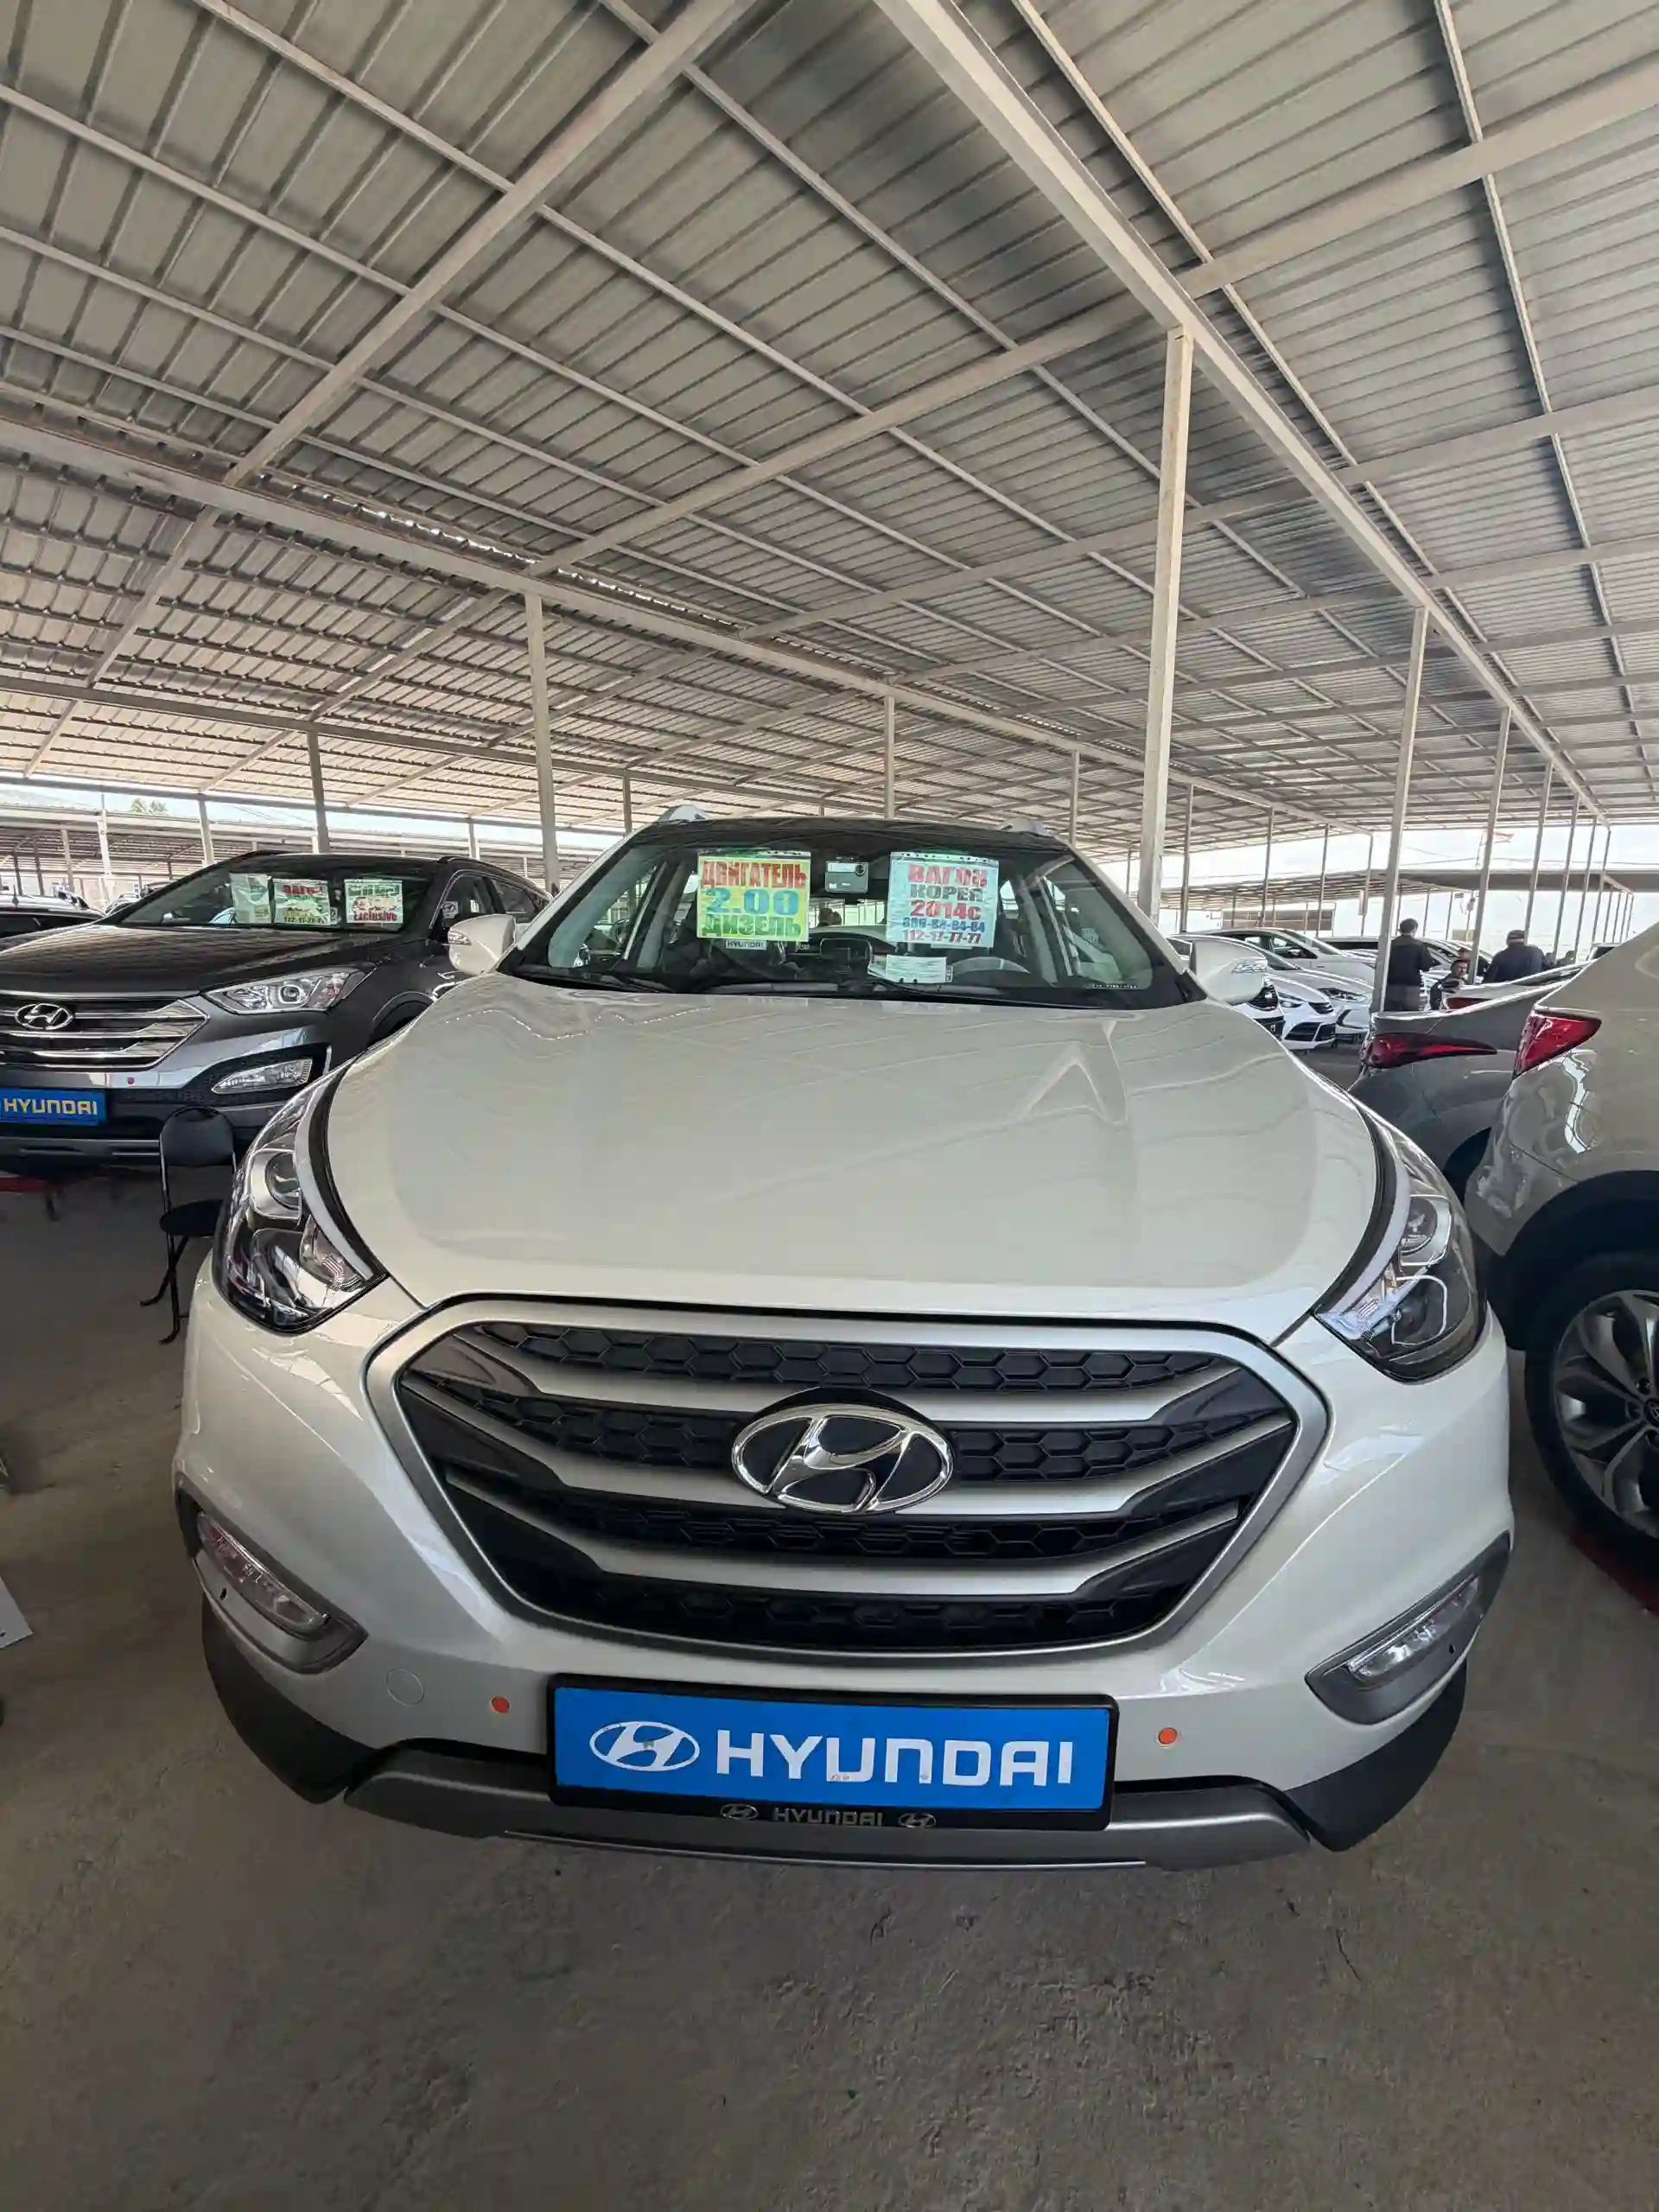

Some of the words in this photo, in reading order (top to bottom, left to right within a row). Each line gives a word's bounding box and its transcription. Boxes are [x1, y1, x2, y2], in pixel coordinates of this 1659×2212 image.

[701, 861, 807, 889] ДВИГАТЕЛЬ
[705, 887, 799, 915] 2.00
[701, 914, 802, 938] ДИЗЕЛЬ
[3, 1097, 98, 1116] HYUNDAI
[715, 1729, 1073, 1787] HYUNDAI
[773, 1807, 883, 1827] HYUNDAI
